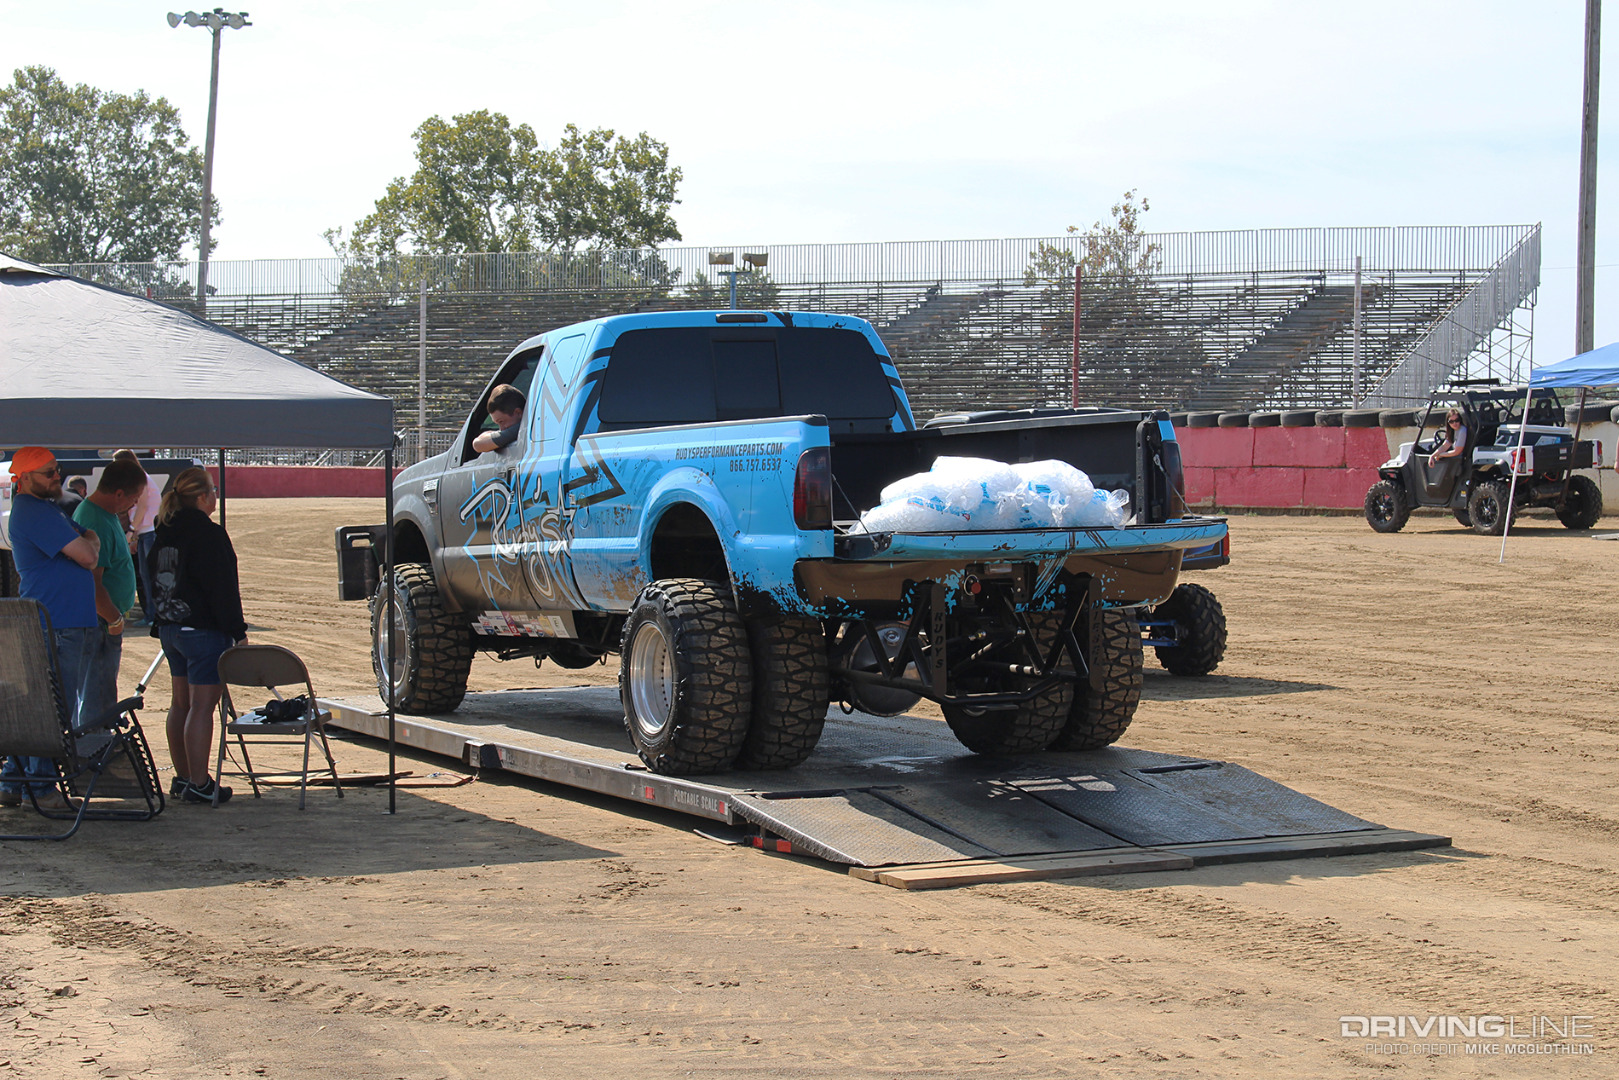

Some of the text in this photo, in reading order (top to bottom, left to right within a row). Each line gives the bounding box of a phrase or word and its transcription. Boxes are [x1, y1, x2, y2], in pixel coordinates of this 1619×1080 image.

[675, 443, 783, 459] RUDYSPERFORMANCEPARTS.COM
[674, 789, 718, 812] PORTABLE SCALE
